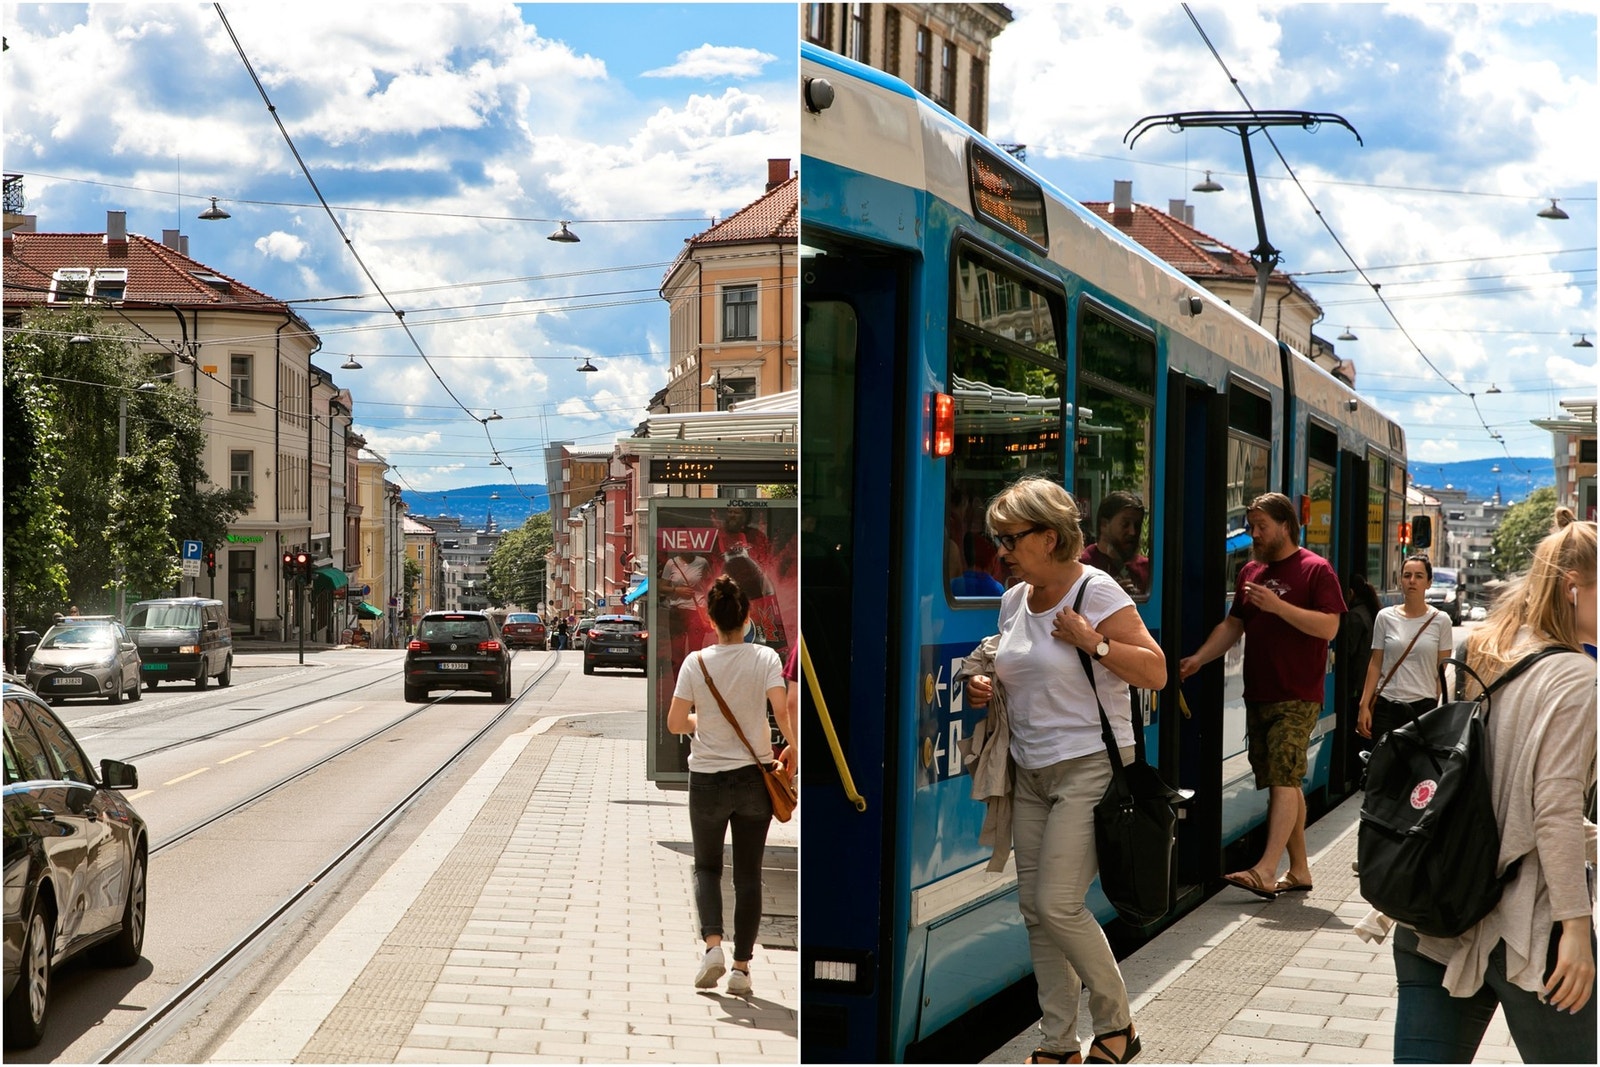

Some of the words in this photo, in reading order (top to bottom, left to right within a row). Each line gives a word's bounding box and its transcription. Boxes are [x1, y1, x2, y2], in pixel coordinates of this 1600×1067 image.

[726, 499, 768, 508] JCDecaux
[662, 529, 710, 550] NEW
[187, 543, 198, 558] P
